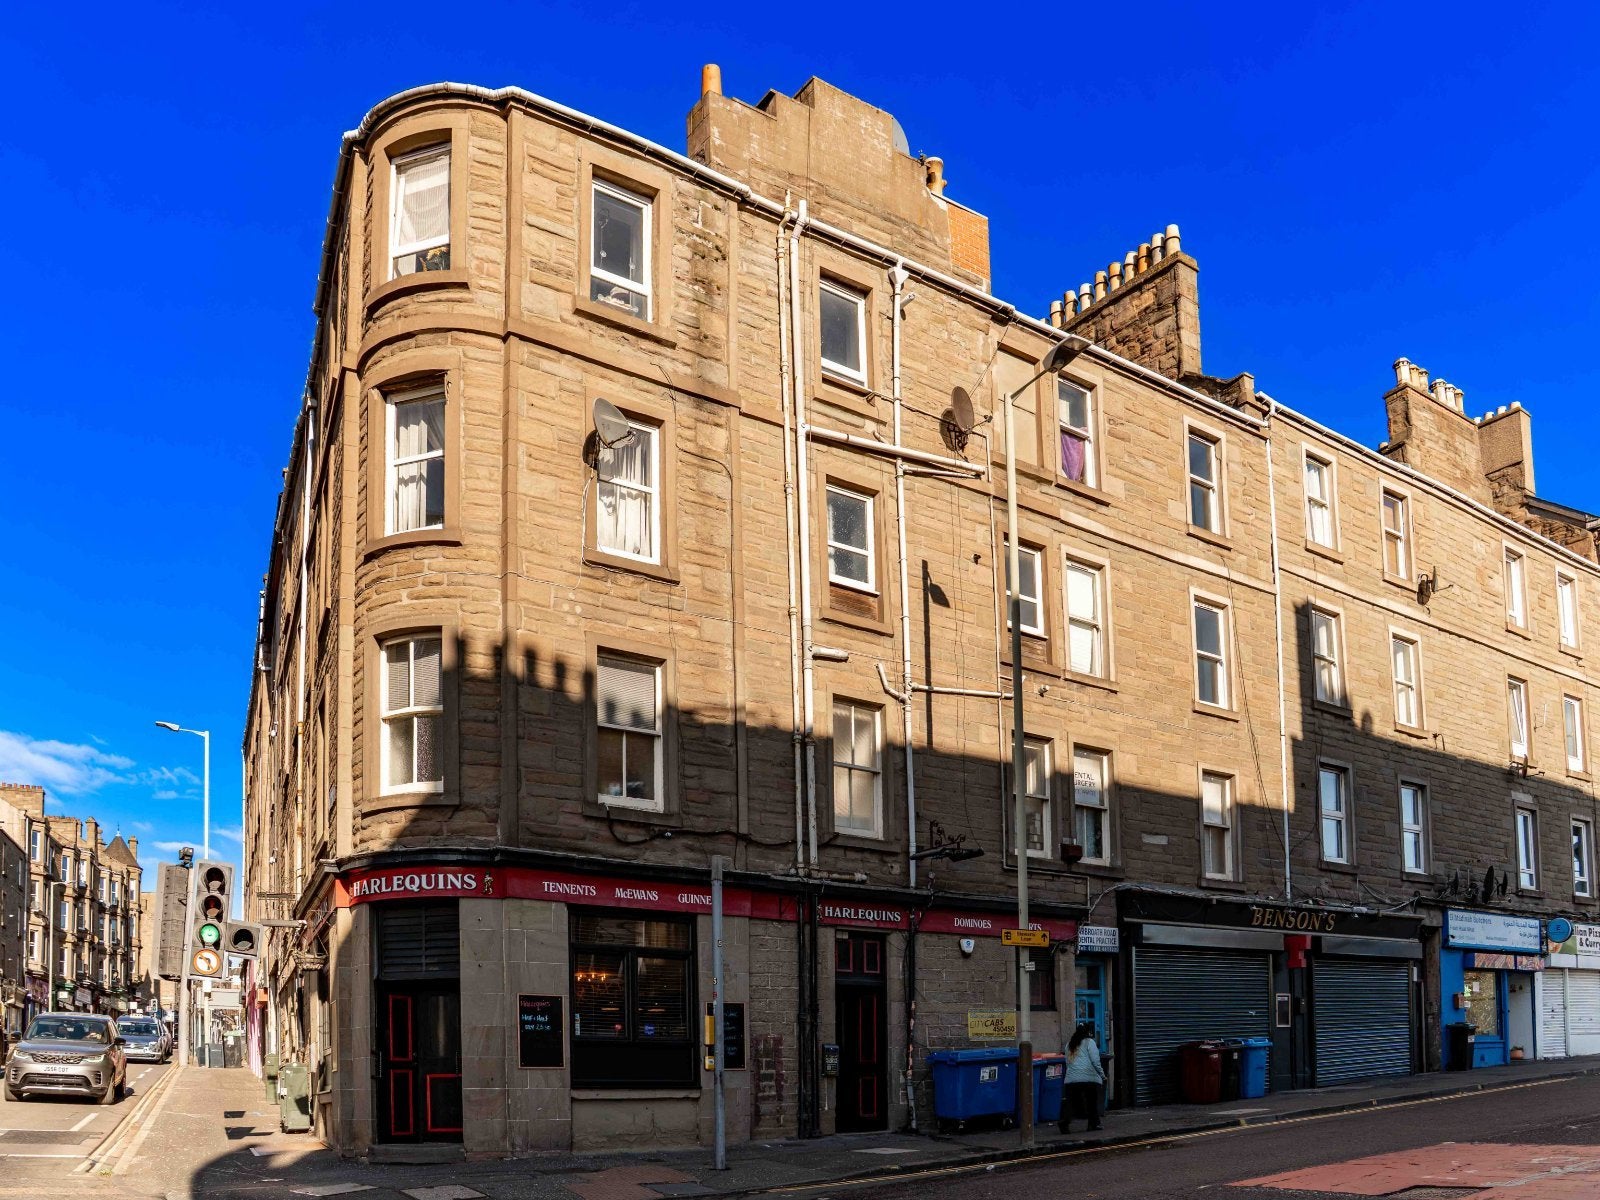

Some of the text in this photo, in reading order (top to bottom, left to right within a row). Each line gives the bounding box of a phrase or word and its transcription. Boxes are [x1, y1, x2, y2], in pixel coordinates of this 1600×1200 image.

[1074, 771, 1095, 781] ENTAL
[1074, 779, 1096, 788] URGERY
[353, 873, 477, 897] HARLEQUINS
[542, 881, 596, 896] TENNENTS
[614, 887, 659, 901] McEWANS
[677, 893, 712, 905] GUINNE
[824, 906, 902, 922] HARLEQUINS
[1251, 907, 1336, 931] BENSON'S
[954, 917, 992, 929] DOMINOES
[1028, 922, 1042, 931] RTS
[1104, 928, 1117, 937] ROAD
[1078, 936, 1117, 946] DENTAL PRACTICE
